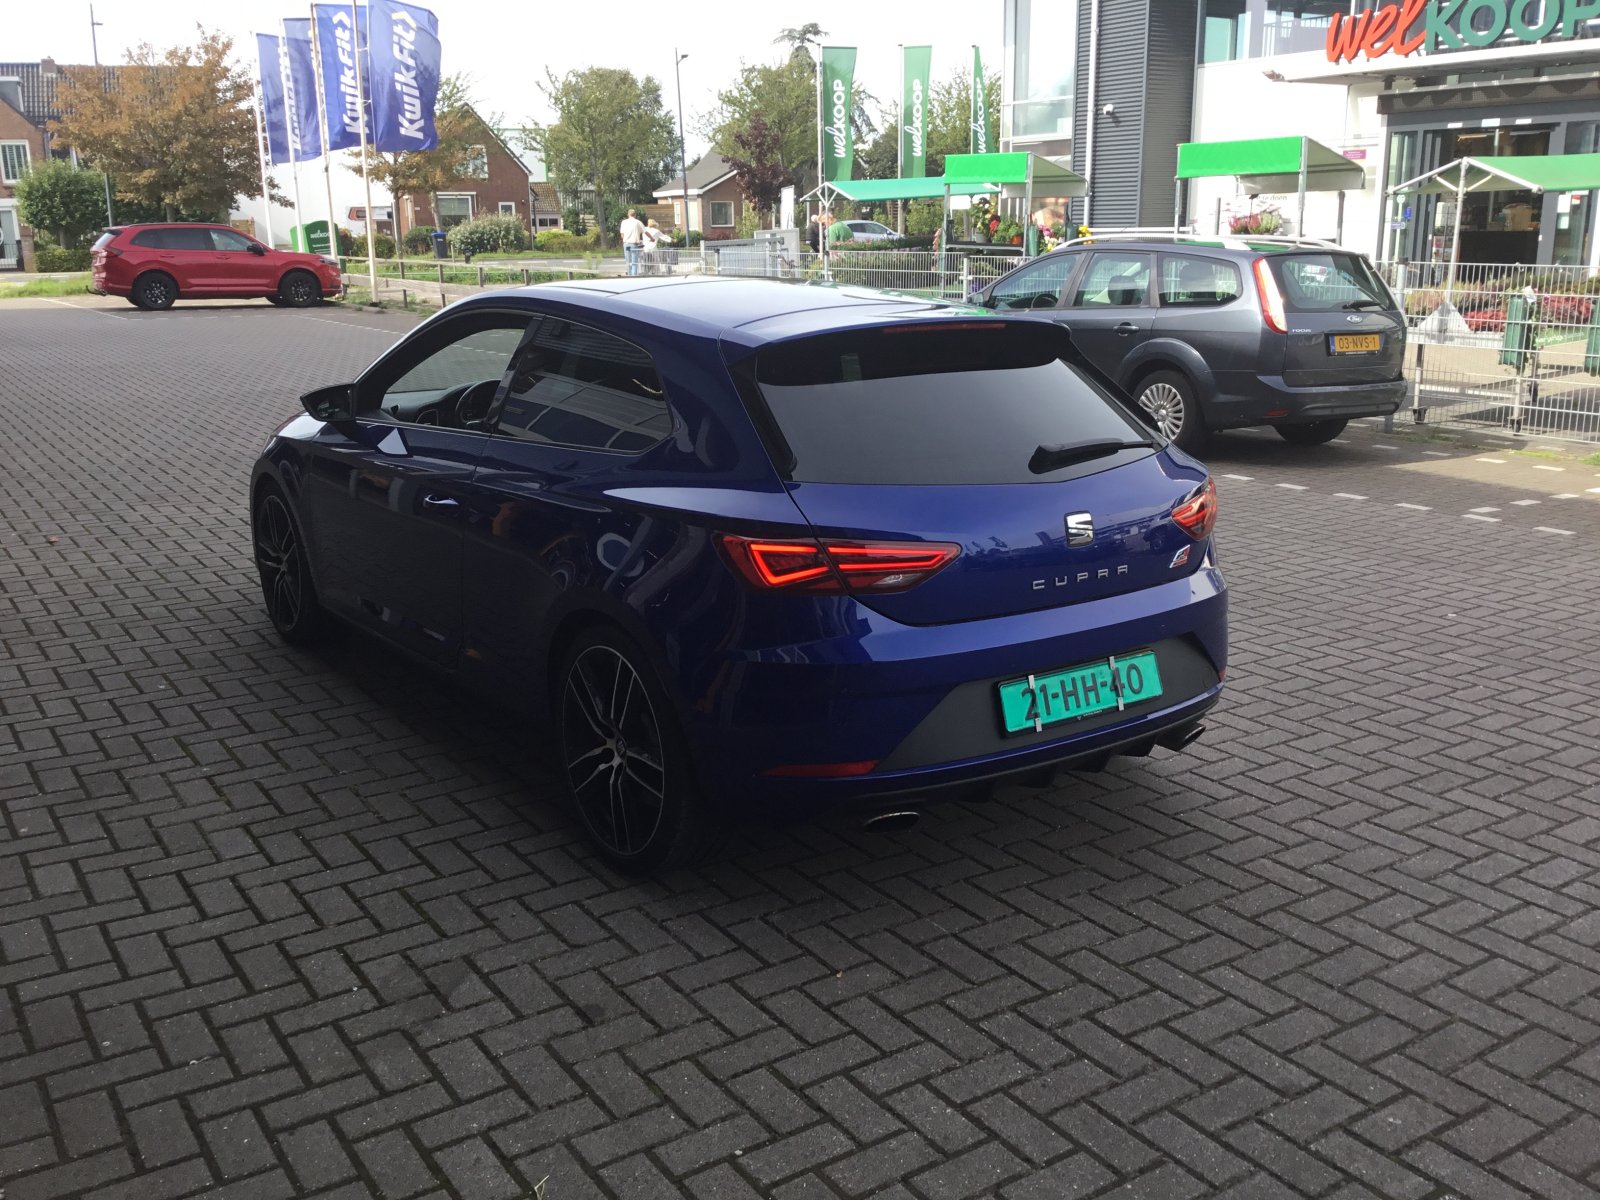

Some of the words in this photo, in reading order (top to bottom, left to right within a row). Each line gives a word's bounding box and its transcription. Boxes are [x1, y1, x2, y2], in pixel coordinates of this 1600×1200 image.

[1338, 337, 1377, 350] 03-NVS-1
[1032, 565, 1129, 590] CUPRA
[1021, 663, 1143, 720] 21-HH-40
